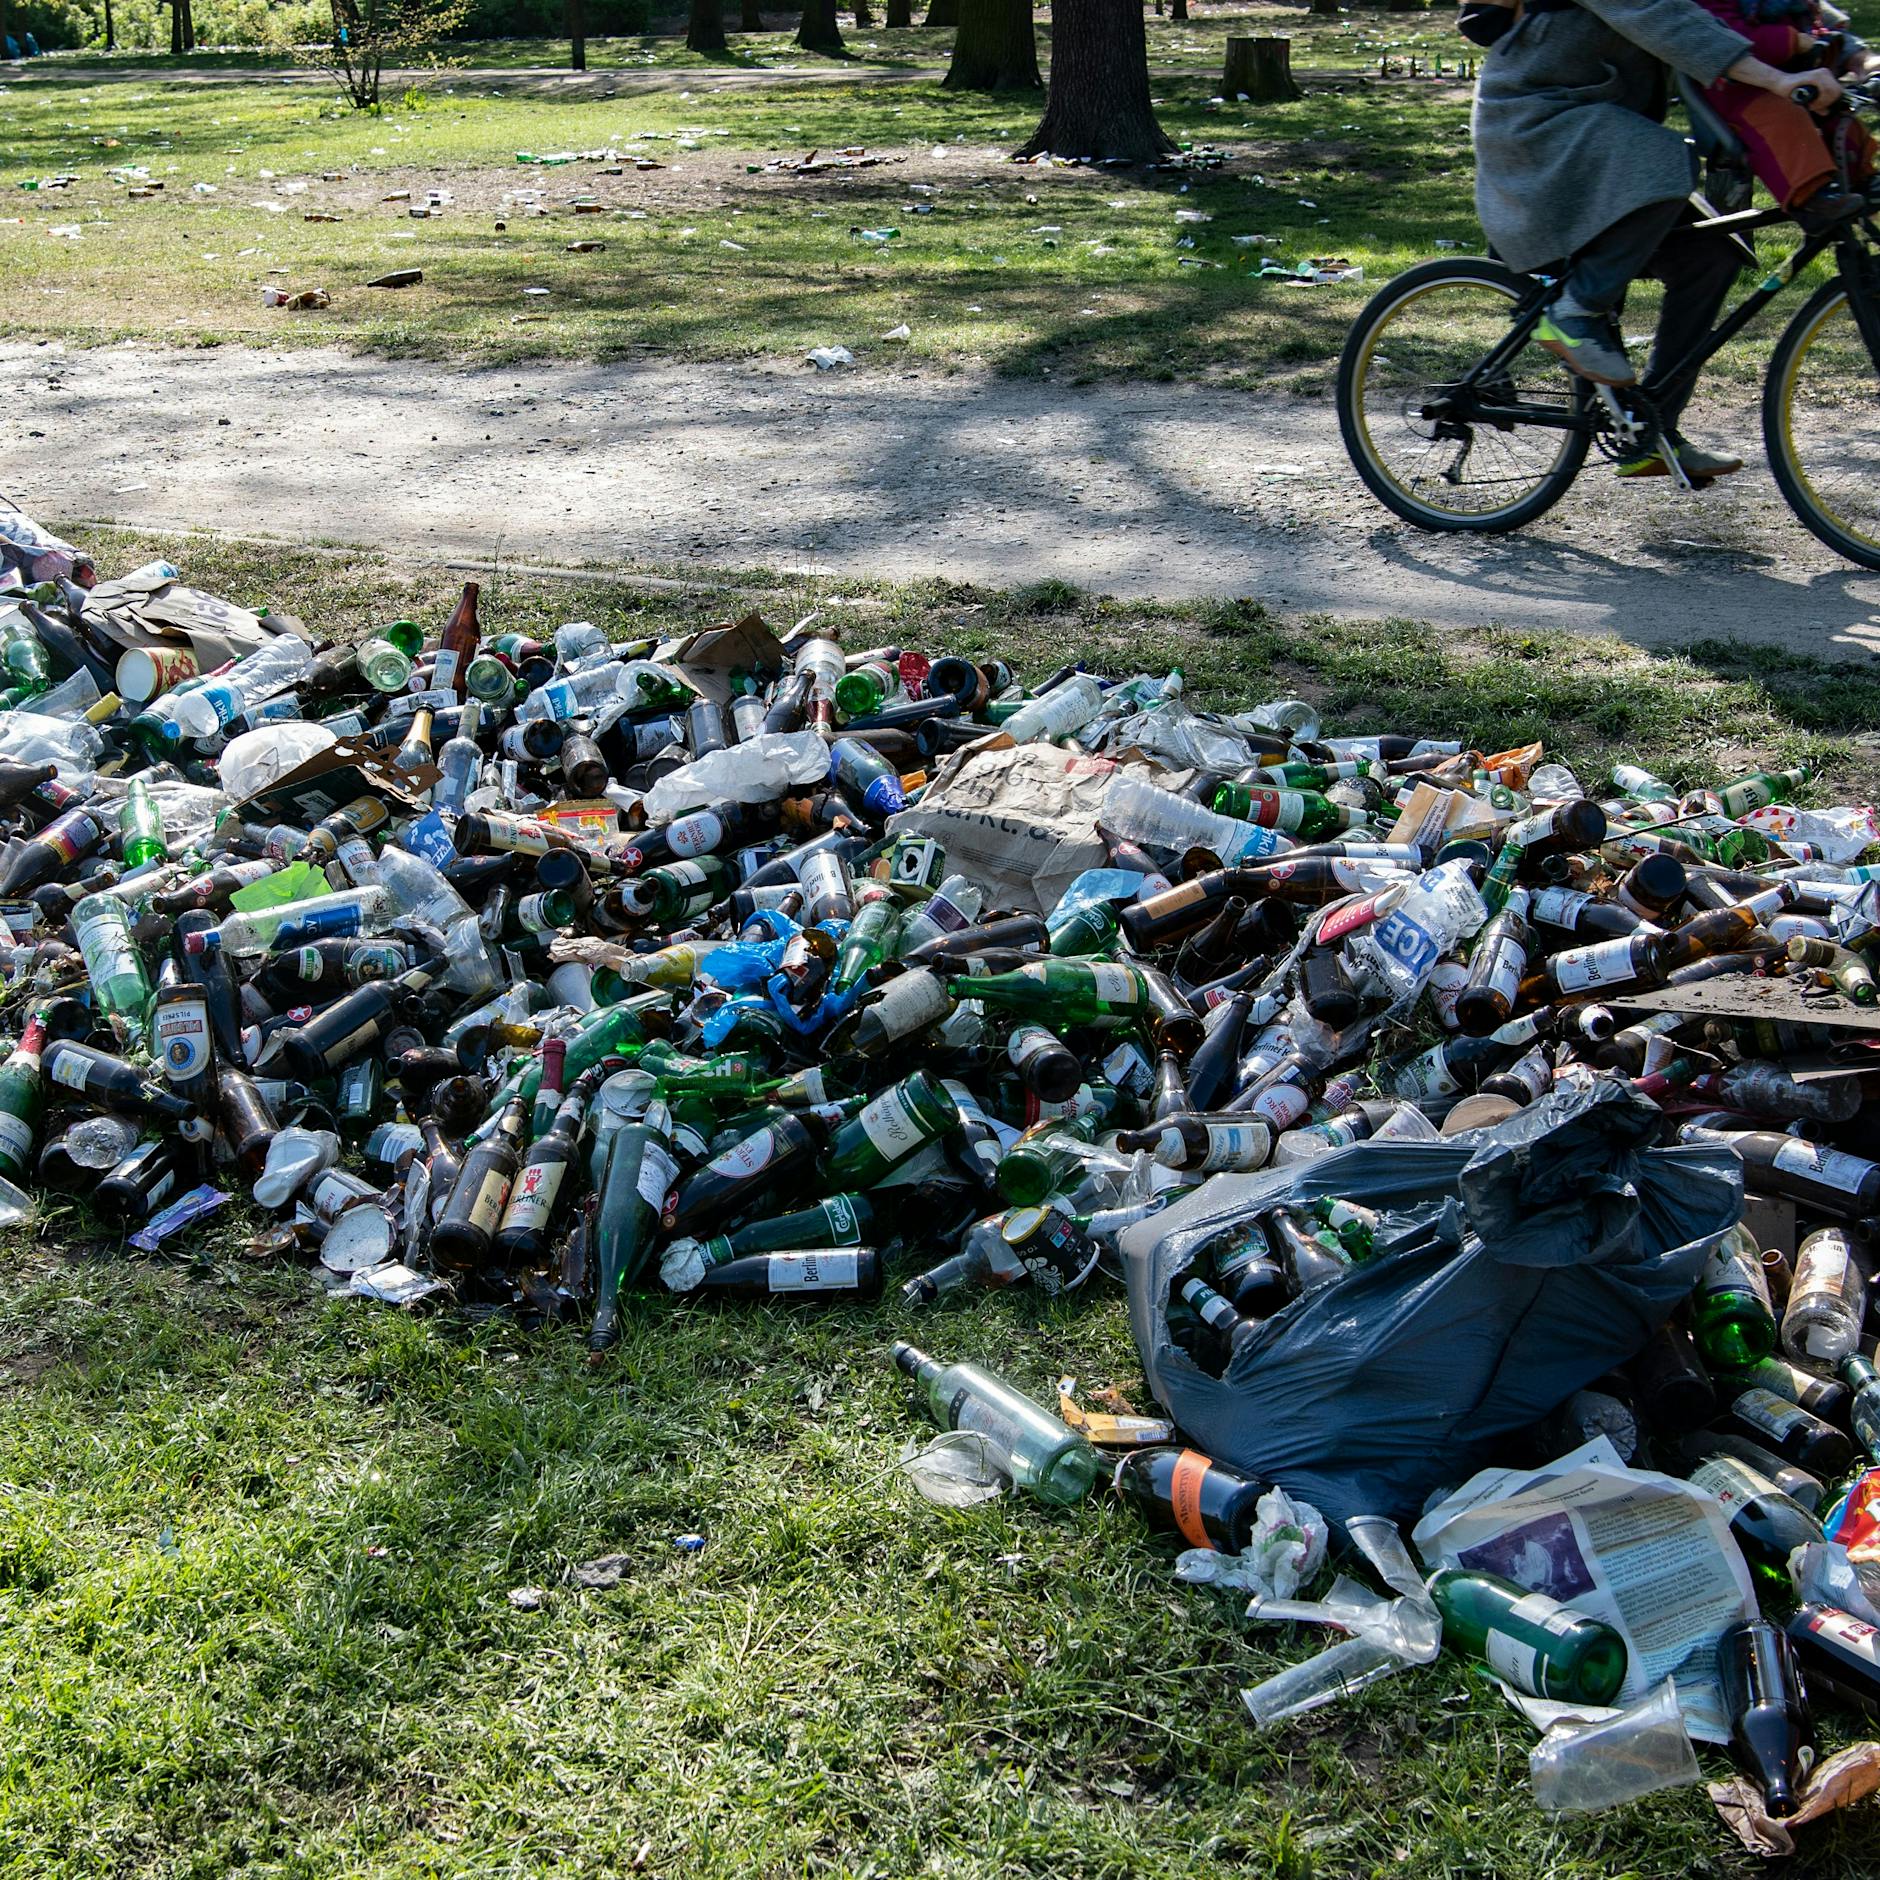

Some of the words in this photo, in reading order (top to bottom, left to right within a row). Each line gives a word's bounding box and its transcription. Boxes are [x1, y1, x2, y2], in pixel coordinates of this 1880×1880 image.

[1743, 786, 1761, 811] JEVE
[1382, 916, 1430, 965] ICE
[1179, 1467, 1190, 1525] MIONETTO
